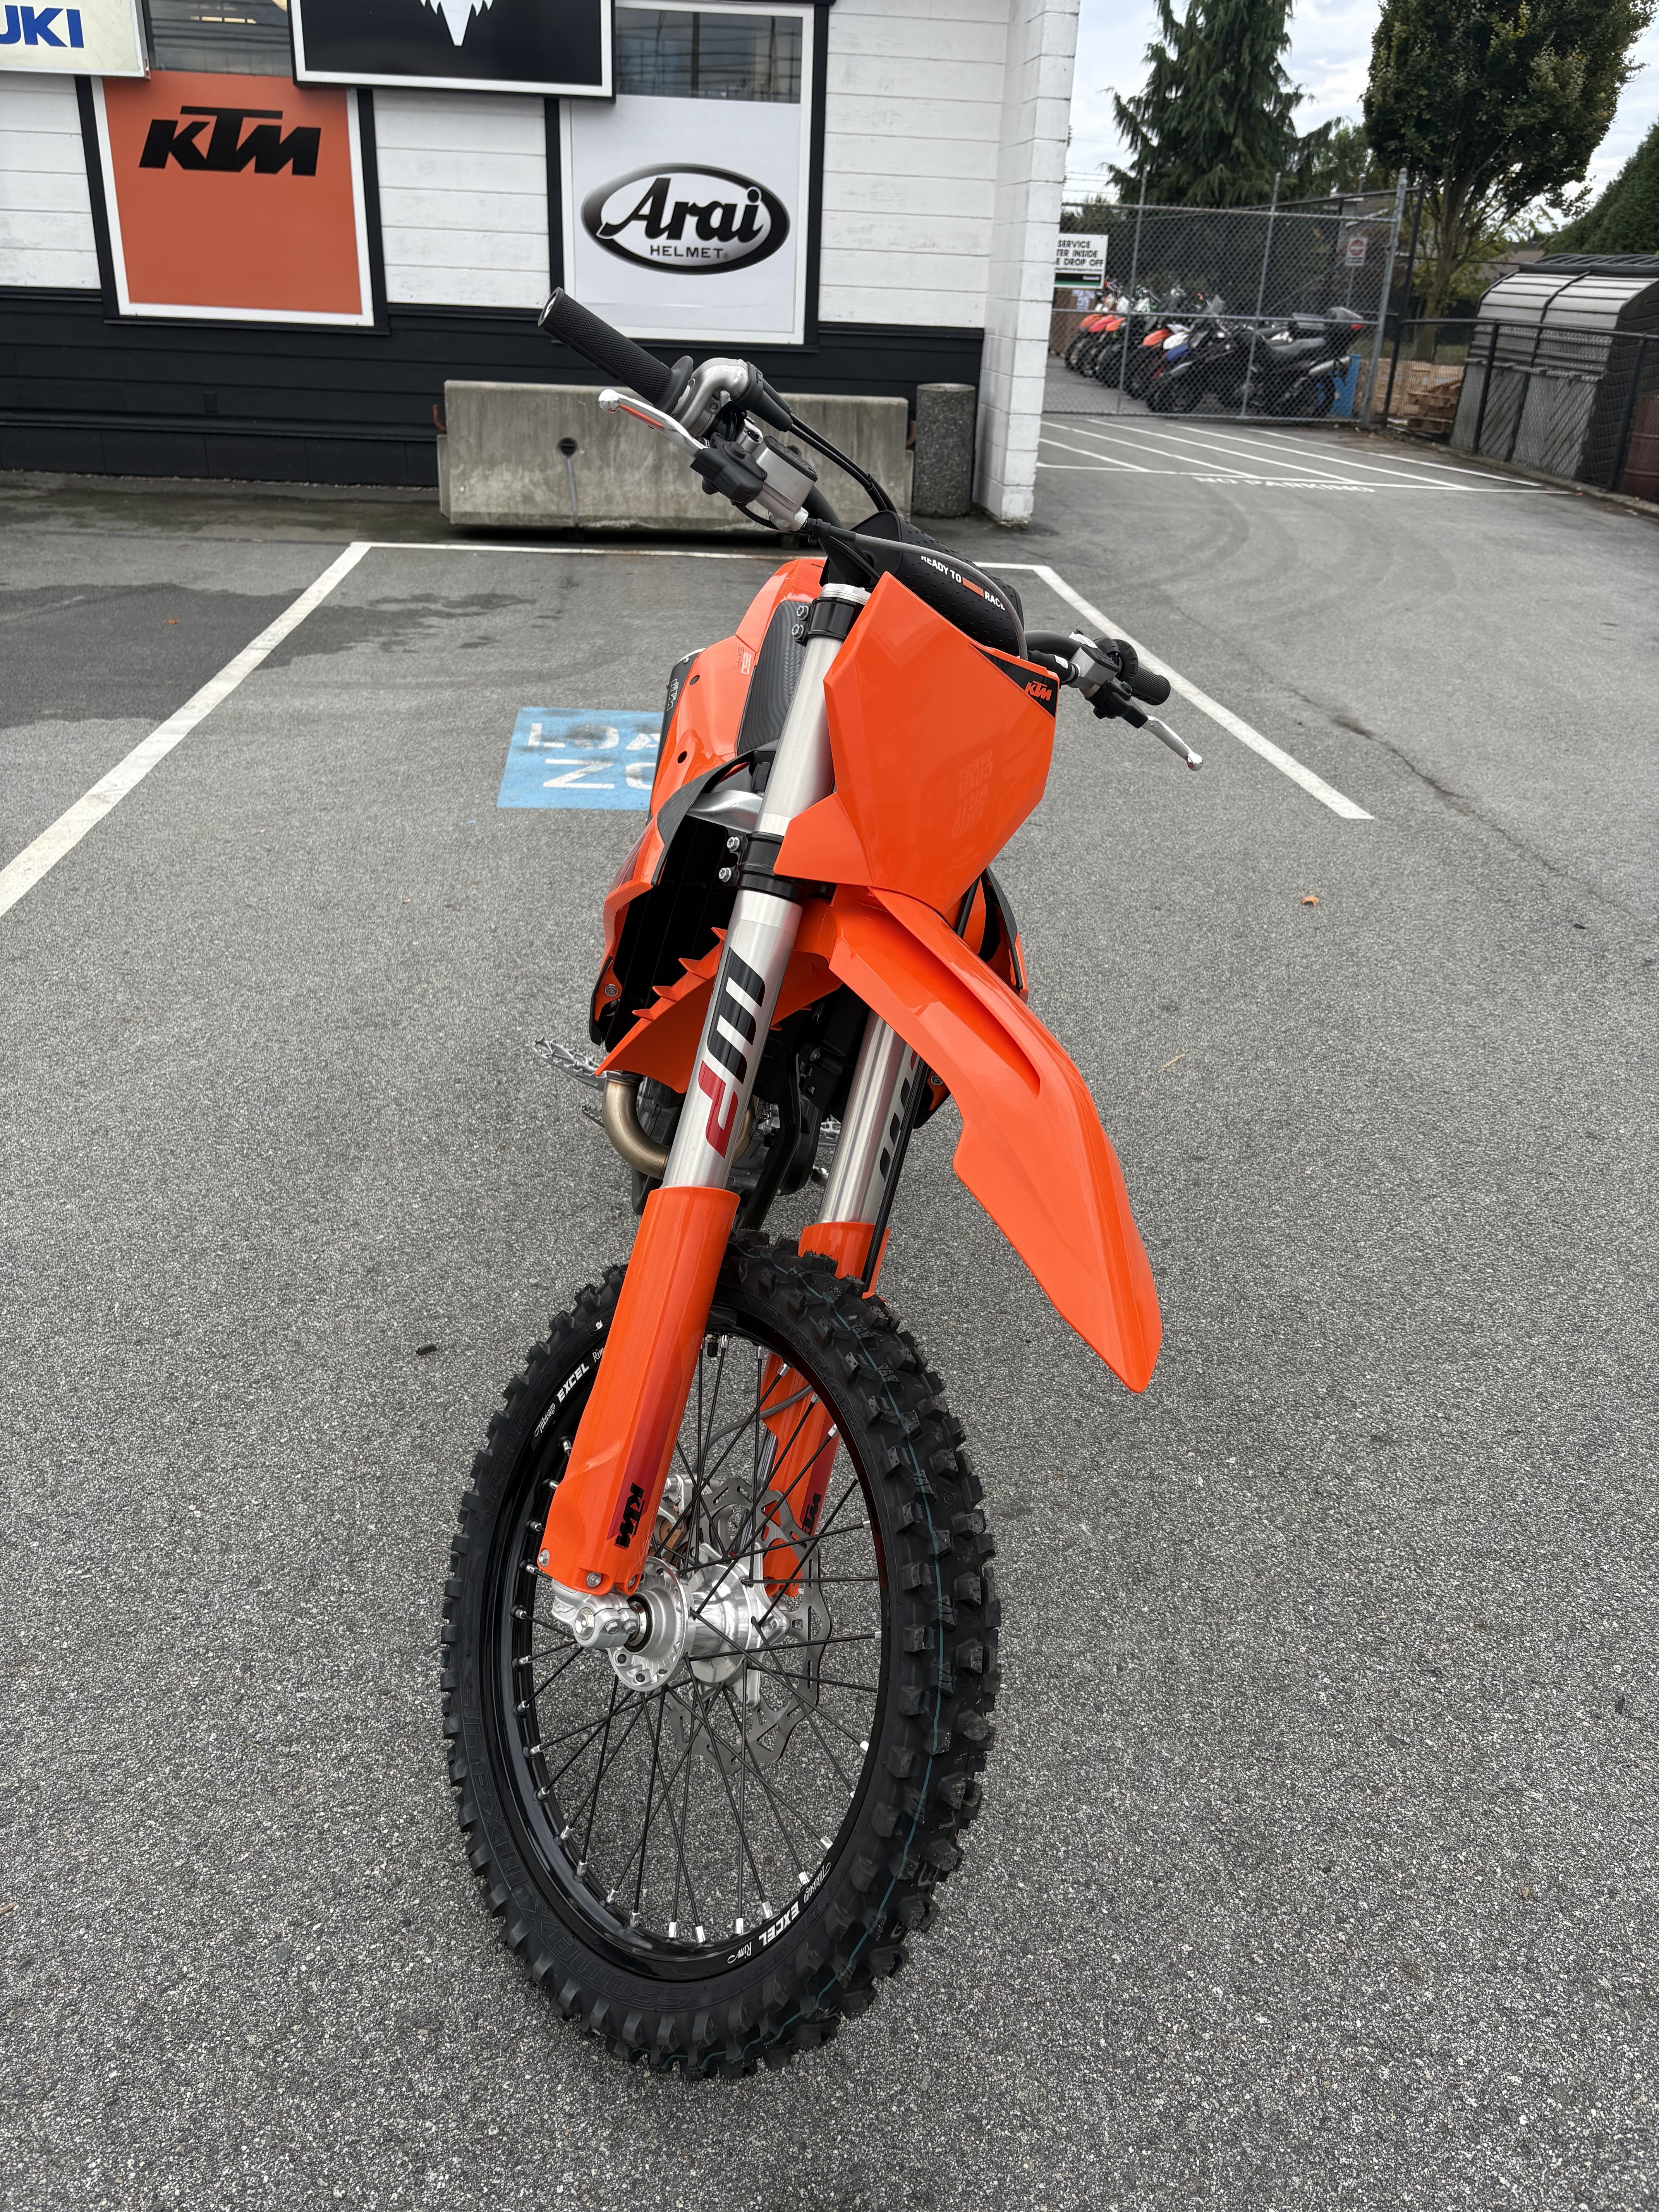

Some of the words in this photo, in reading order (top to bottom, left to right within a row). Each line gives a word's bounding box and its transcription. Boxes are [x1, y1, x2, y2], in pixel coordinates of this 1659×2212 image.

[139, 106, 321, 177] KTM
[599, 177, 764, 243] Arai
[650, 244, 723, 259] HELMET
[1057, 240, 1091, 248] SERVICE
[1072, 249, 1098, 258] INSIDE
[950, 570, 961, 583] TO
[741, 653, 752, 675] 250
[1024, 680, 1052, 701] KTM
[534, 1403, 556, 1437] Takasago
[556, 1362, 589, 1403] EXCEL
[592, 1347, 604, 1362] Rim
[614, 1482, 644, 1548] KTM
[804, 1862, 831, 1904] Takasago
[759, 1901, 800, 1946] EXCEL
[524, 1892, 696, 2009] GEOMAX
[727, 1941, 752, 1964] Rim
